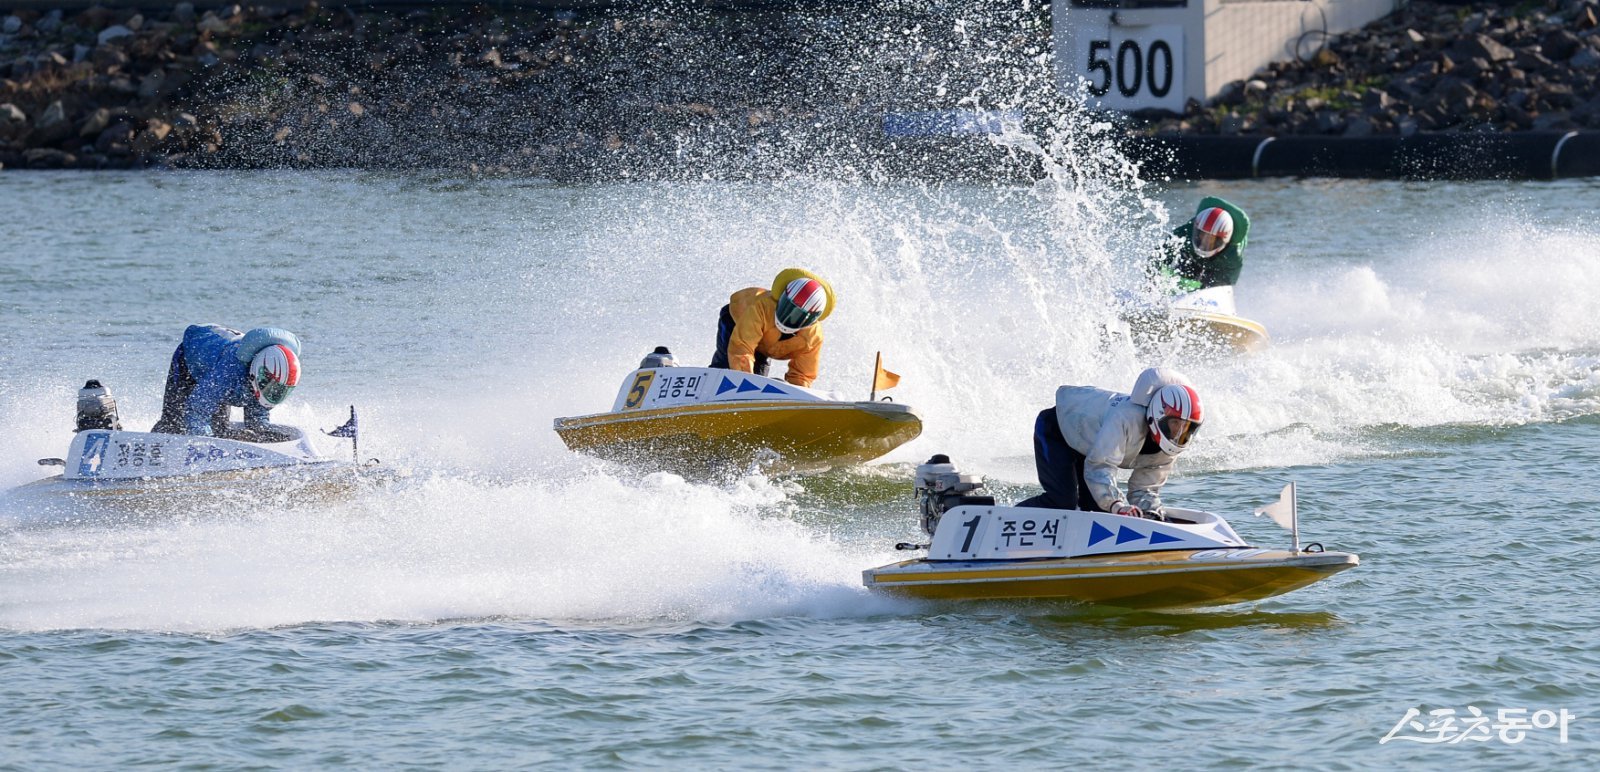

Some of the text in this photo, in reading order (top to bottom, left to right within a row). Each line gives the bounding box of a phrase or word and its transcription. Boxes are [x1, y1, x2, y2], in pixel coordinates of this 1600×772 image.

[1086, 39, 1173, 98] 500
[626, 374, 701, 407] 5 김종민
[82, 438, 105, 472] 4
[960, 515, 1060, 553] 1 주은석
